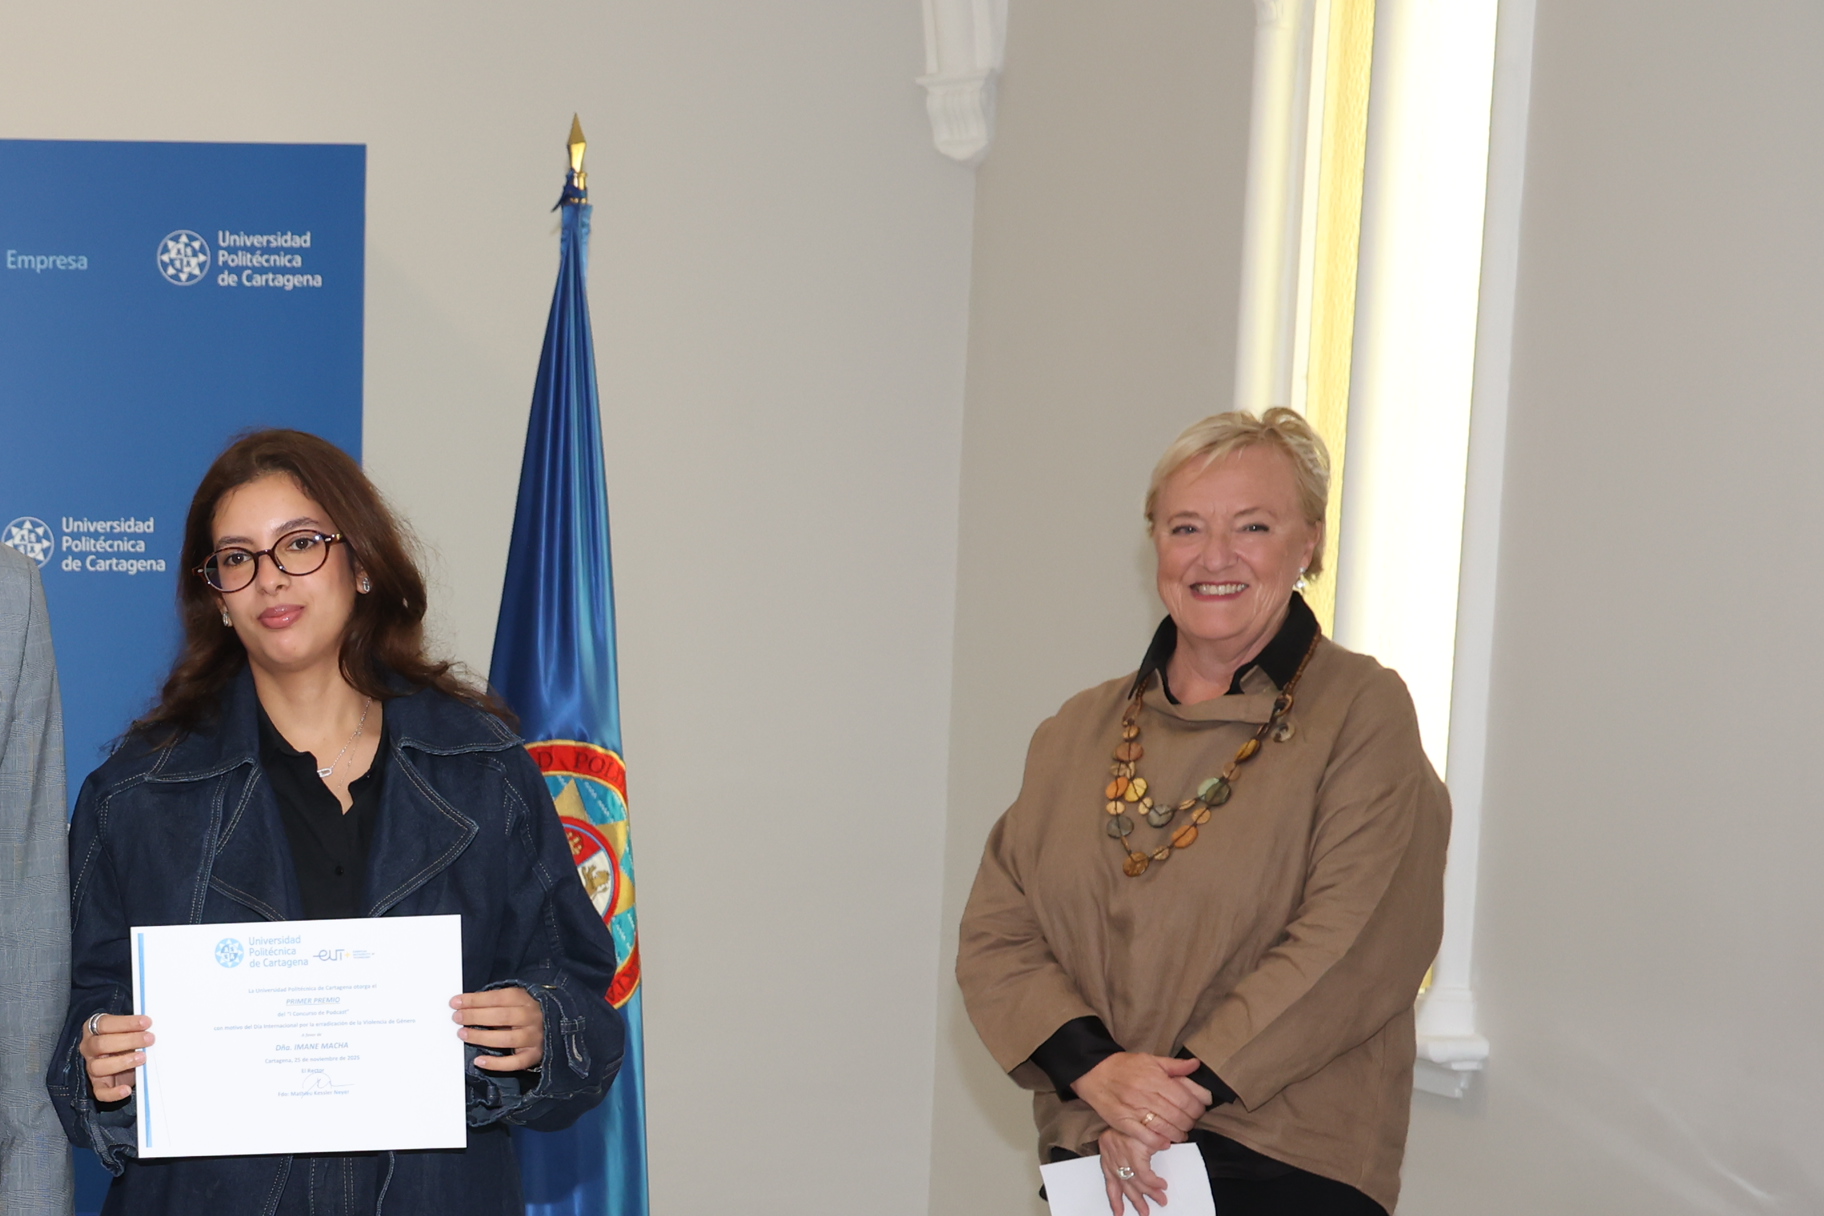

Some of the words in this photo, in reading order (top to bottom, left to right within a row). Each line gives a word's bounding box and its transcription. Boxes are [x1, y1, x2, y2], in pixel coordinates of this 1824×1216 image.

[219, 231, 310, 249] Universidad
[7, 250, 87, 273] Empresa
[218, 250, 301, 267] Politécnica
[218, 270, 238, 286] de
[242, 270, 322, 290] Cartagena
[62, 517, 153, 532] Universidad
[62, 536, 145, 552] Politécnica
[62, 556, 81, 571] de
[86, 555, 165, 575] Cartagena
[248, 935, 301, 946] Universidad
[249, 947, 297, 957] Politécnica
[249, 959, 261, 968] de
[263, 957, 309, 968] Cartagena
